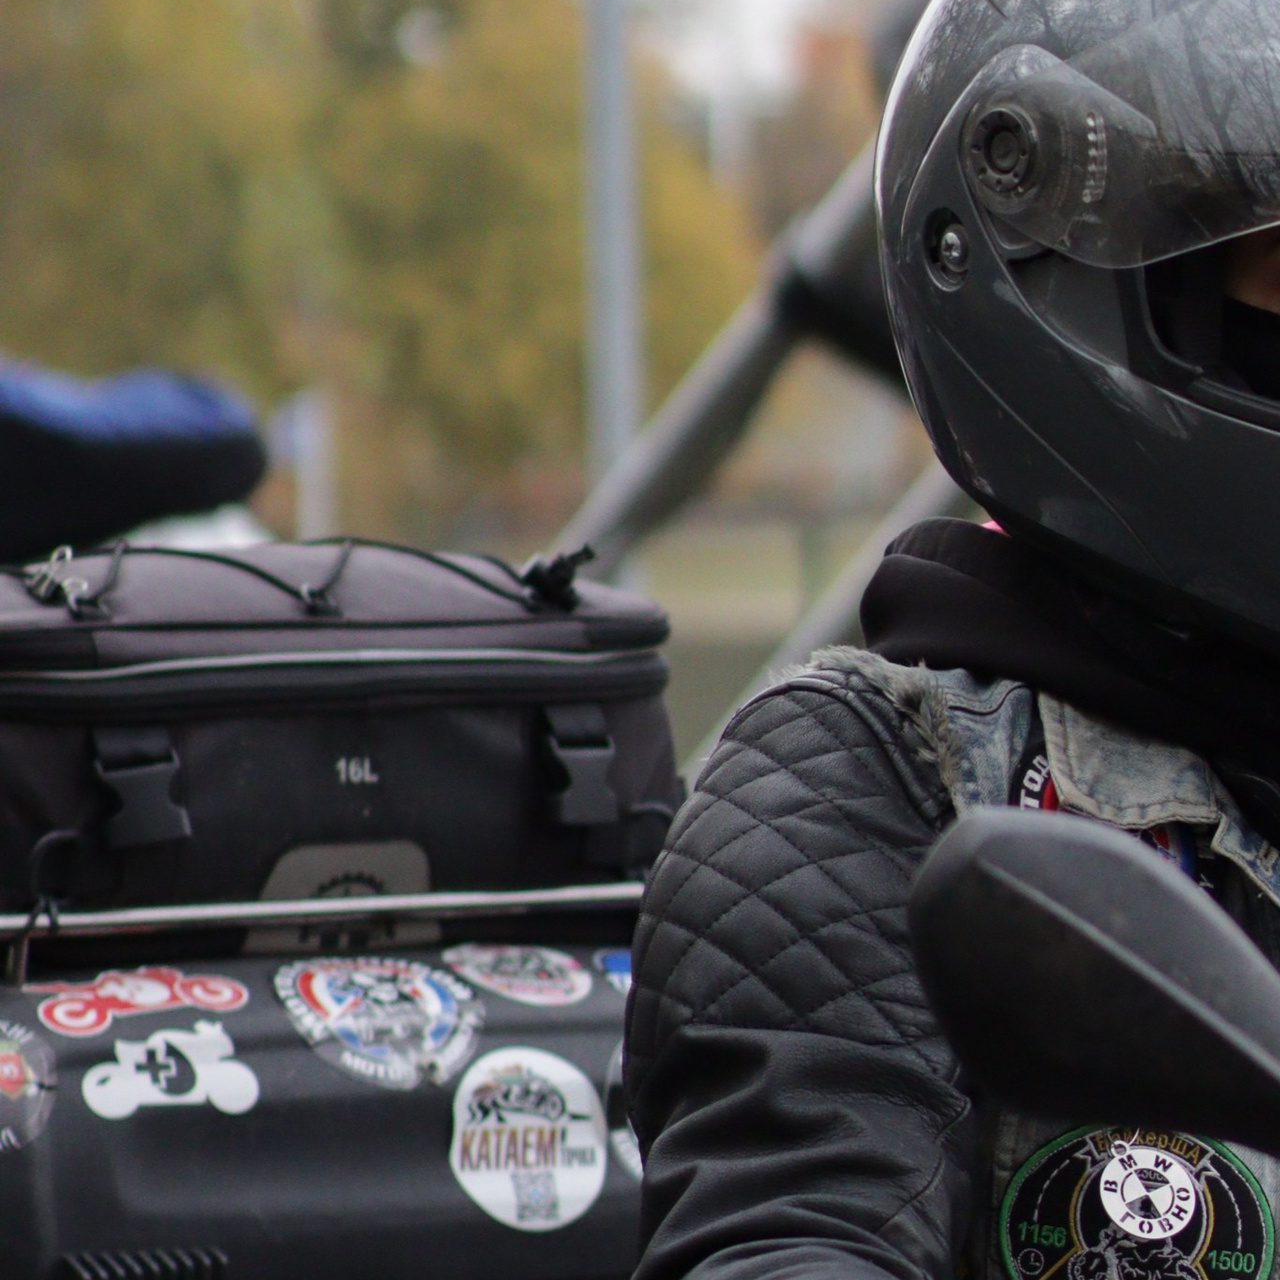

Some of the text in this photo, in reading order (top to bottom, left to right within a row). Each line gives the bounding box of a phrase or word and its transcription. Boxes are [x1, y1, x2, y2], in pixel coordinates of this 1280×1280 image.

[335, 756, 380, 784] 16L
[1118, 1186, 1192, 1235] ГОВНО
[1017, 1220, 1068, 1248] 1156
[1207, 1249, 1257, 1274] 1500
